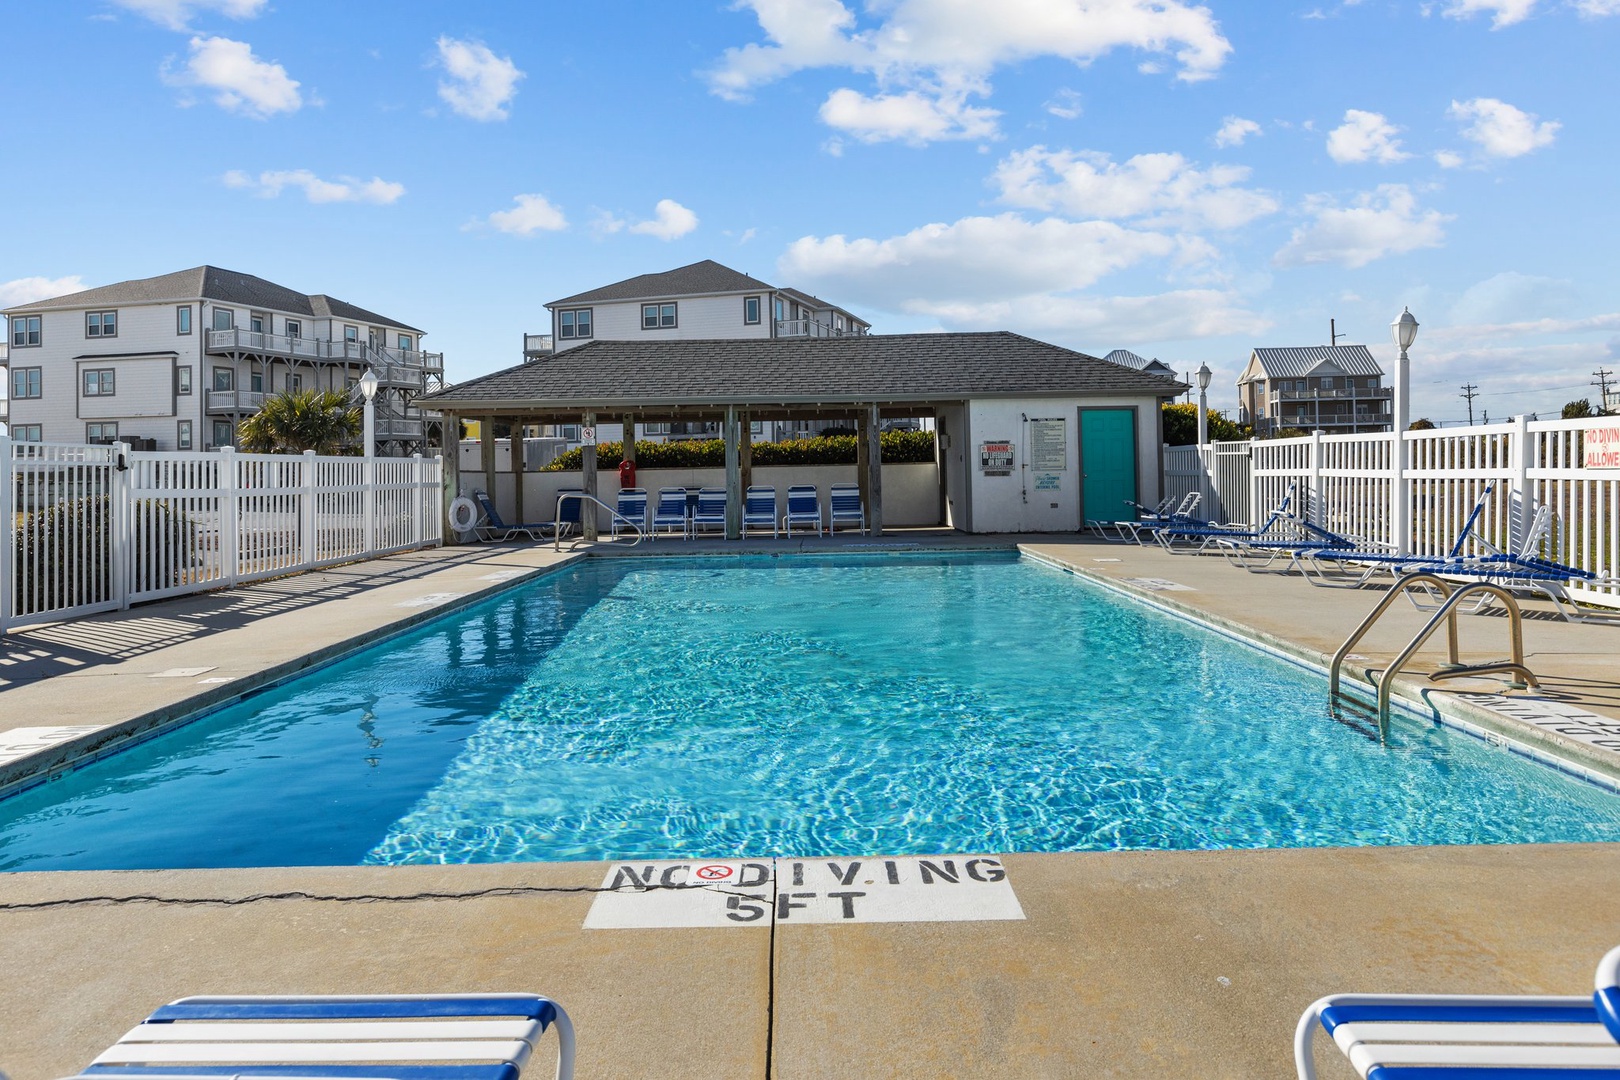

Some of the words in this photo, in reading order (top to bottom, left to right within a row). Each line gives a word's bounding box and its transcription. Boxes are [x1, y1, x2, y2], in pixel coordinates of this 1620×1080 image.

[1587, 429, 1597, 444] NO
[1599, 428, 1620, 443] DIVIN
[1587, 452, 1620, 467] ALLOWE
[732, 858, 1006, 888] DIVING
[727, 891, 867, 921] 5FT
